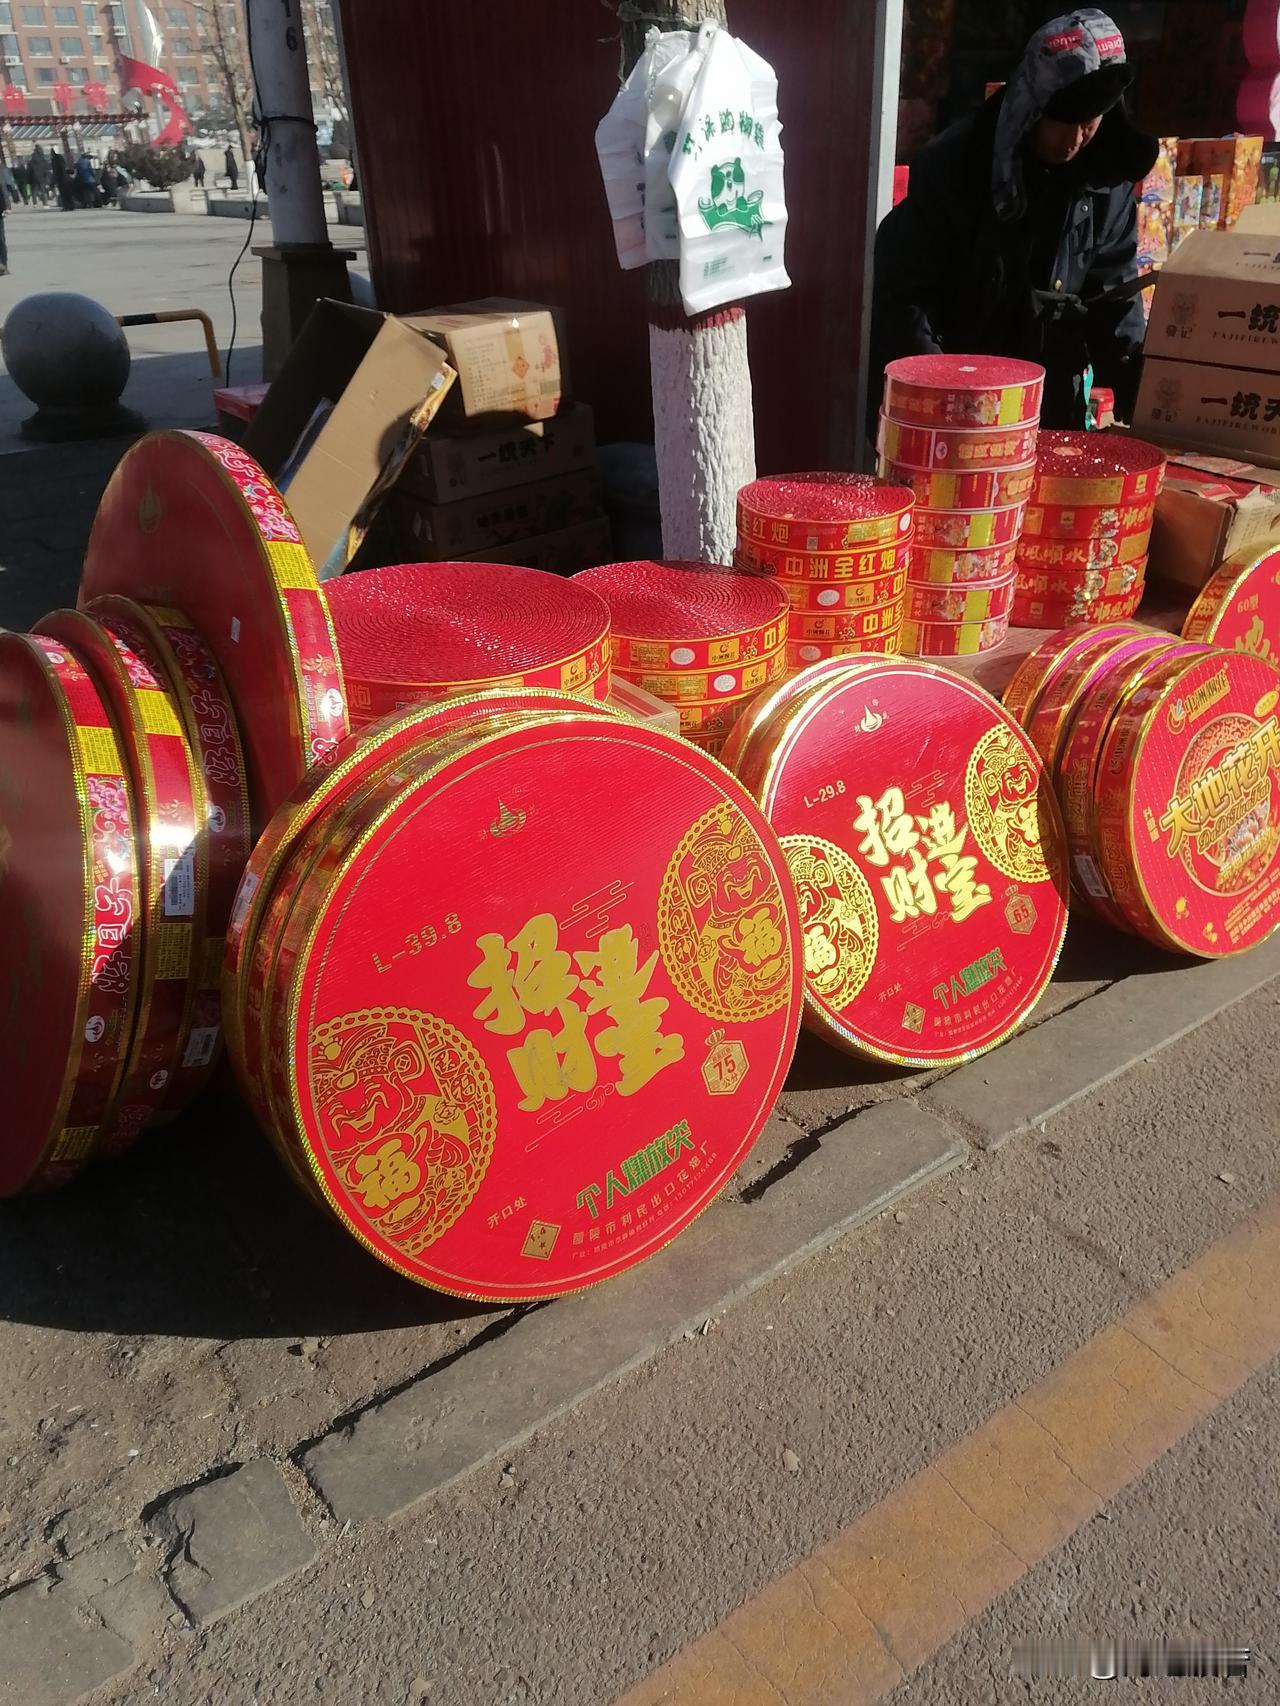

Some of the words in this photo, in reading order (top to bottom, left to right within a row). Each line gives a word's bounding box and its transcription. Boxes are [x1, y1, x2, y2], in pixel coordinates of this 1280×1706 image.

[784, 549, 896, 579] 中洲全红炮
[803, 779, 847, 809] L-29.8
[1013, 905, 1029, 923] 65
[371, 912, 462, 974] L-39.8
[713, 1054, 736, 1080] 75
[486, 1197, 529, 1229] 开口处
